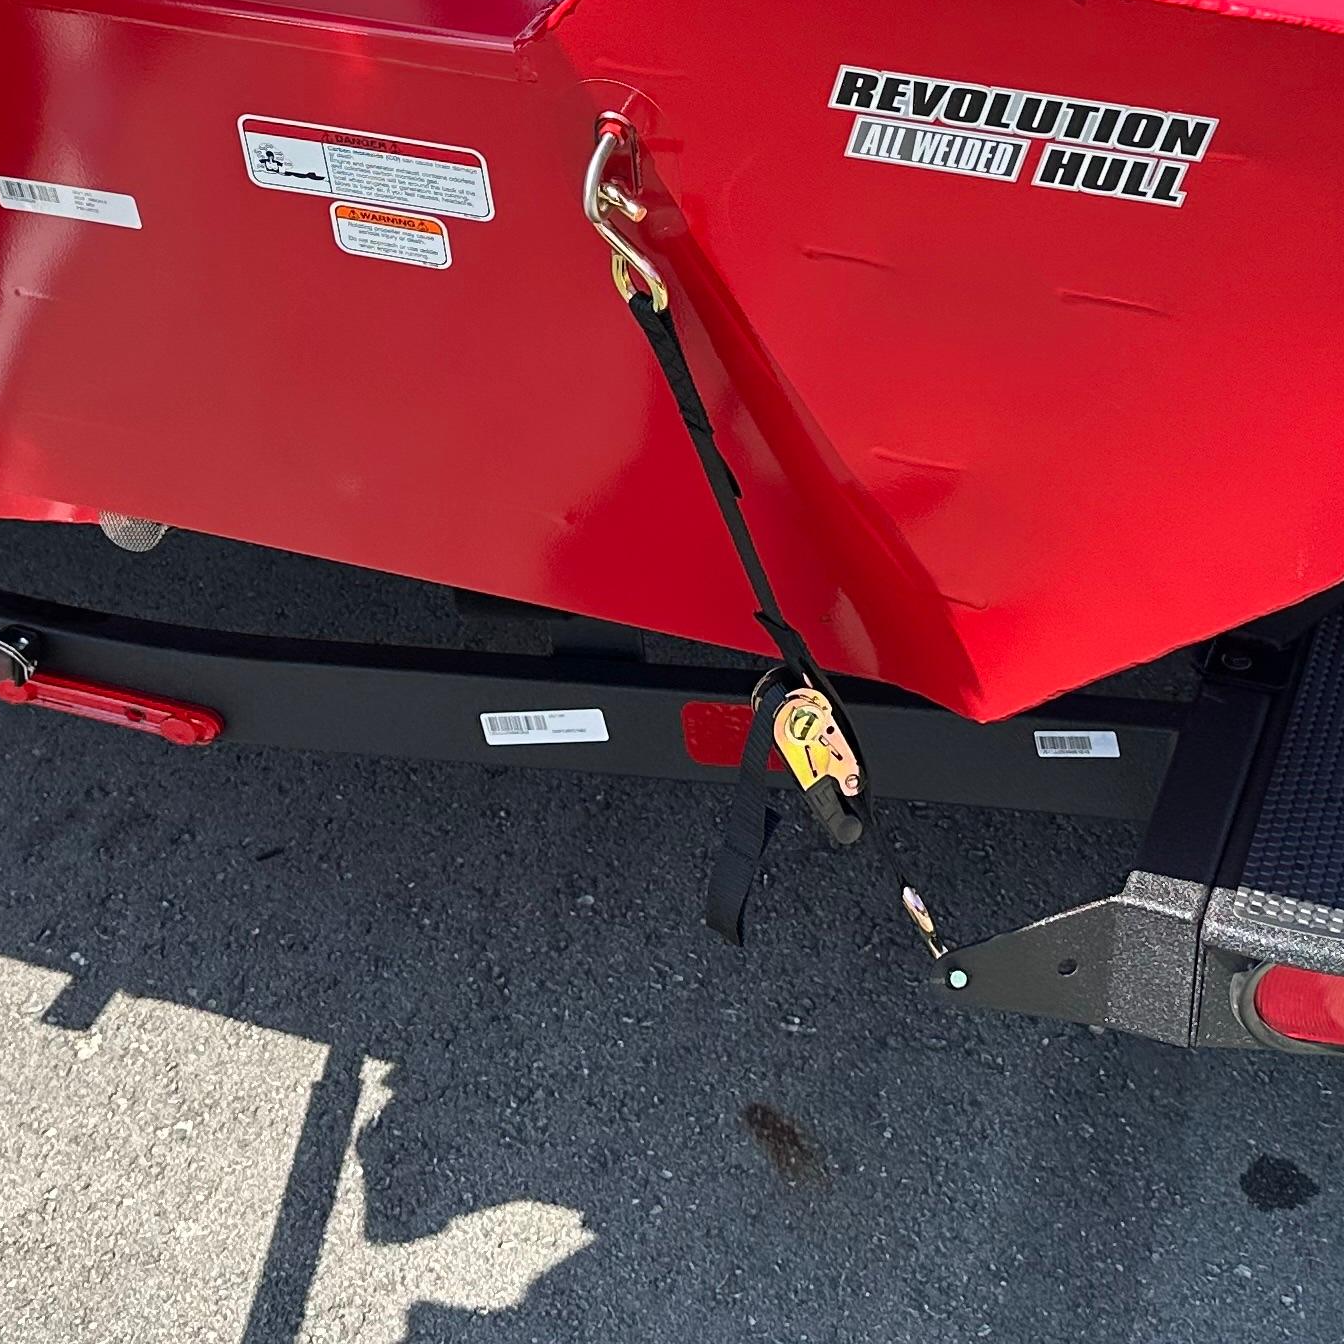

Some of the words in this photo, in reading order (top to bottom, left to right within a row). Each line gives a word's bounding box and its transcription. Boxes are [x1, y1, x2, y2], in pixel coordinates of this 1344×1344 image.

[832, 67, 1215, 161] REVOLUTION
[334, 134, 388, 151] DANGER
[860, 123, 906, 160] ALL
[911, 130, 1014, 175] WELDED
[1038, 147, 1186, 203] HULL
[359, 211, 416, 228] WARNING
